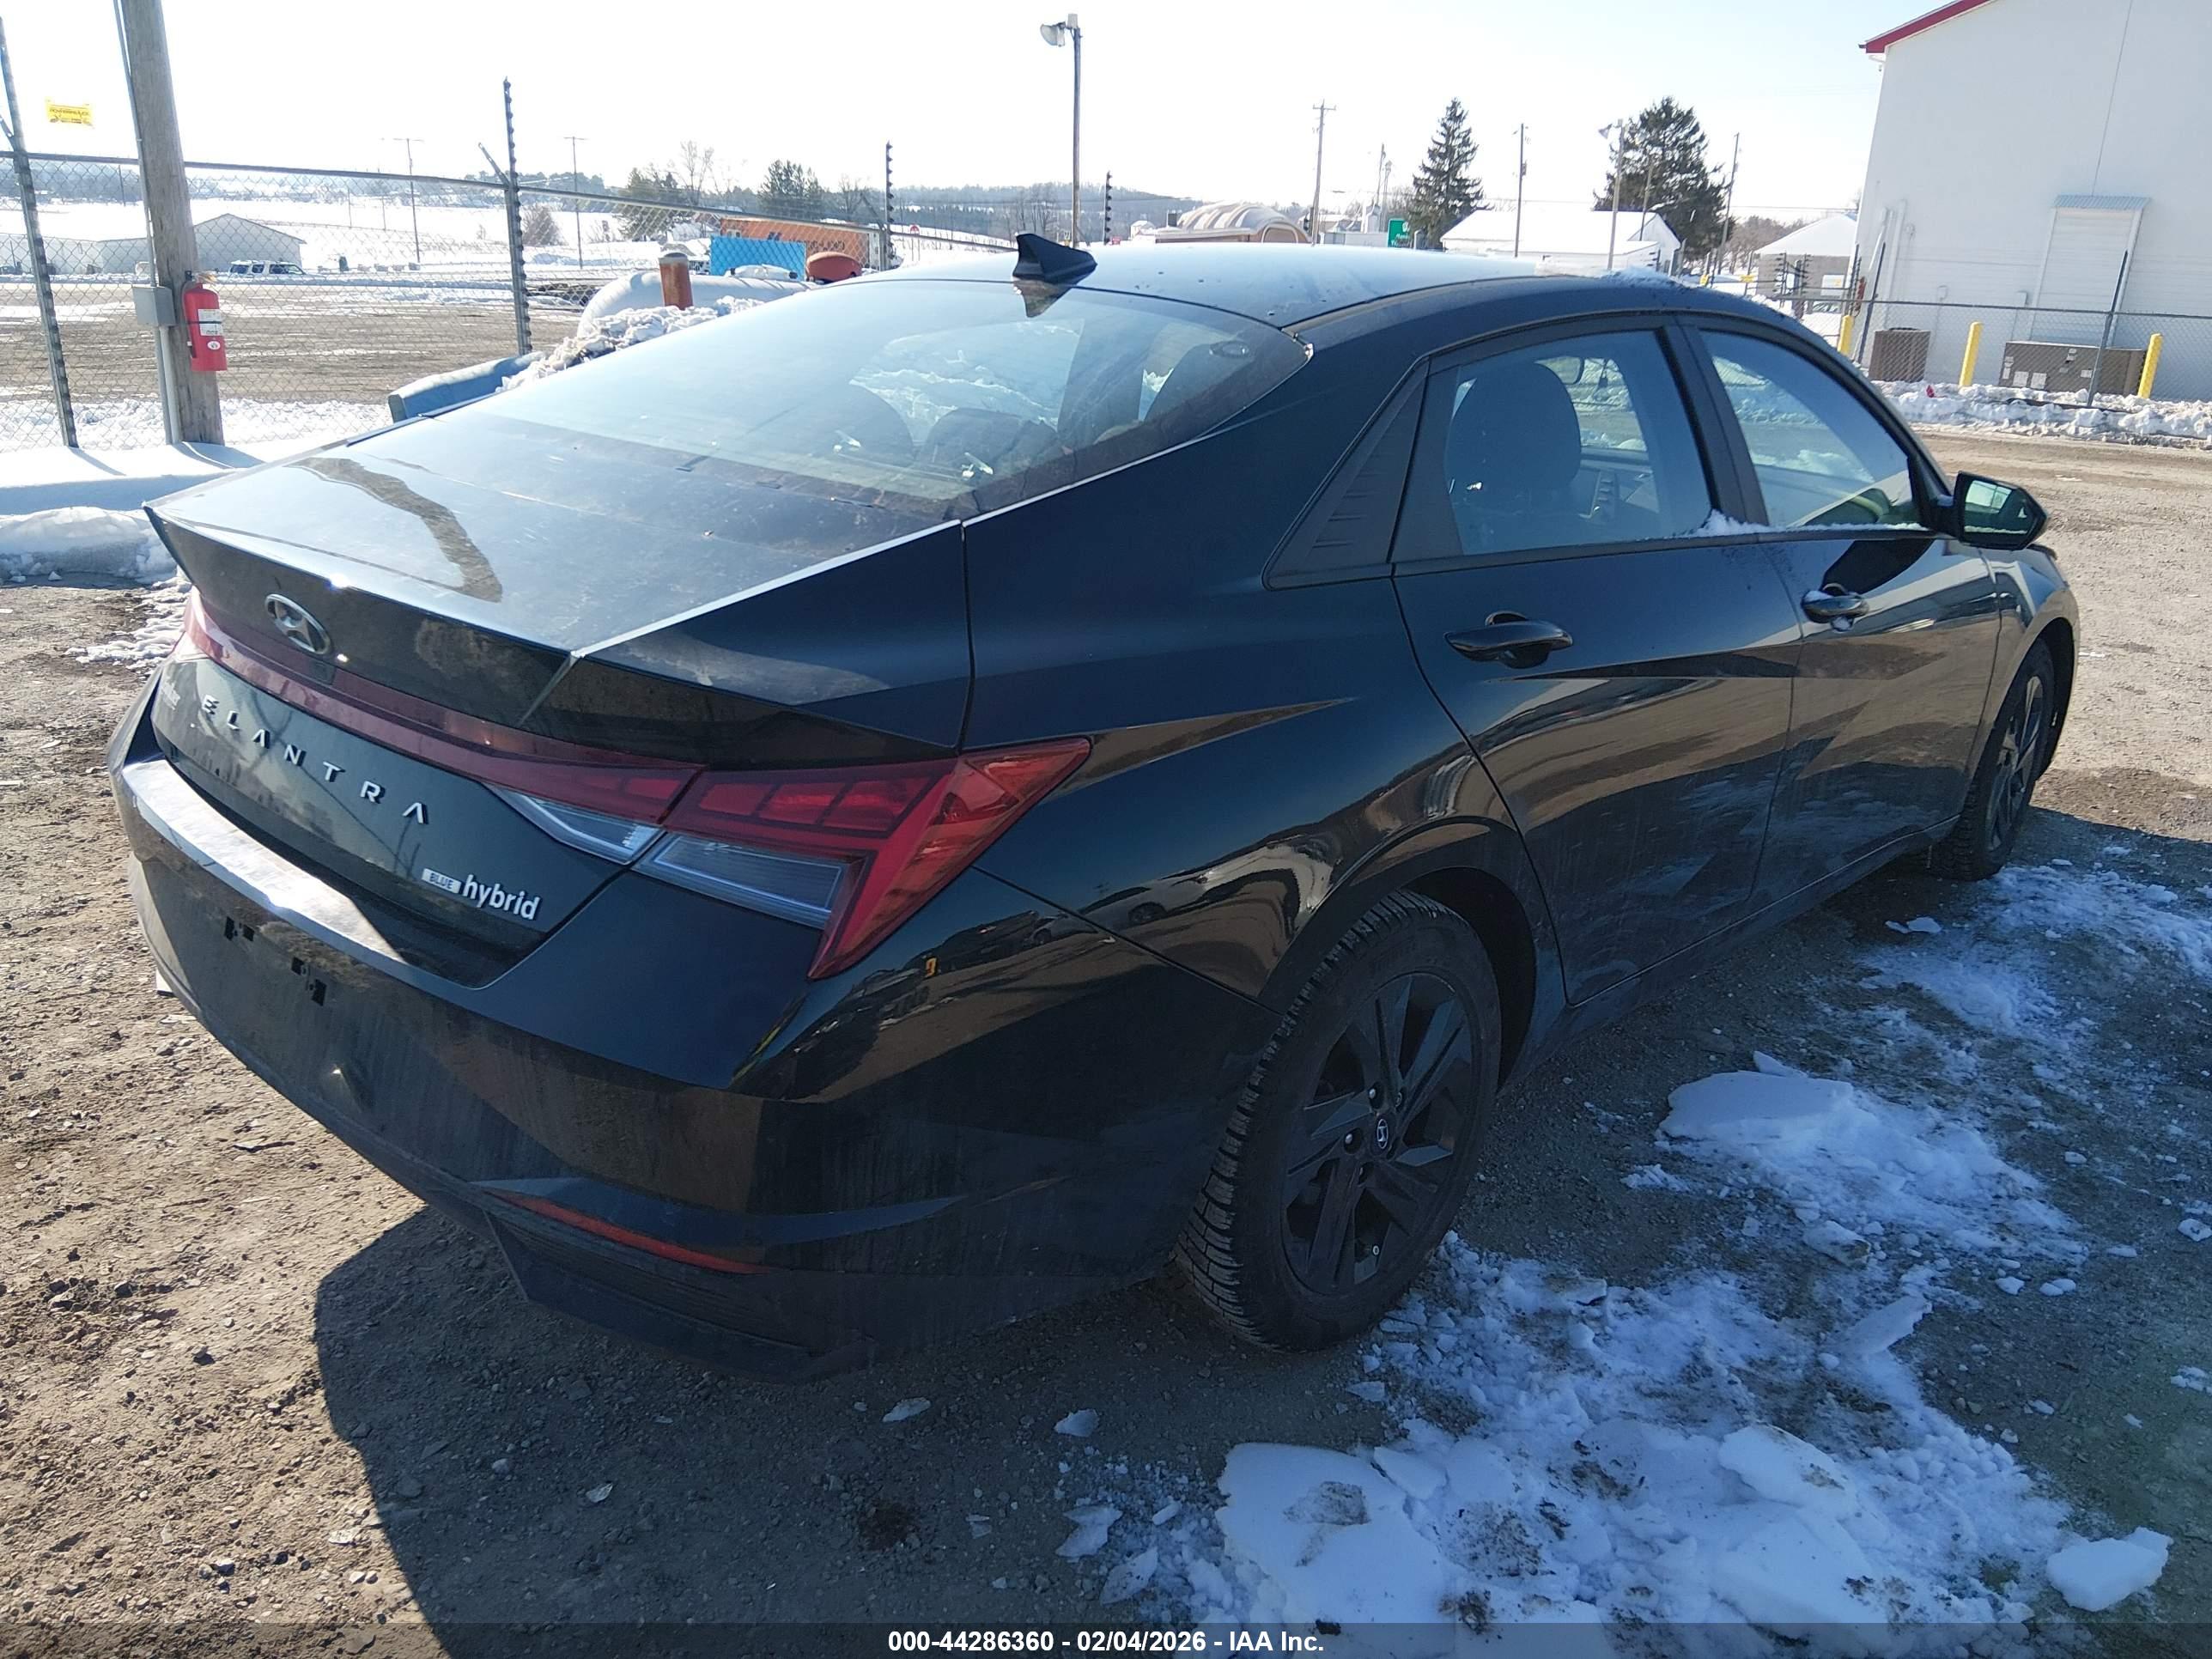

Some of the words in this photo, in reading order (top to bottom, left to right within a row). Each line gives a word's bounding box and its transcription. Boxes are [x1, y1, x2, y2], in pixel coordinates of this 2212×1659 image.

[201, 694, 428, 824] ELANTRA
[428, 872, 454, 890] BLUE
[462, 874, 540, 920] hybrid
